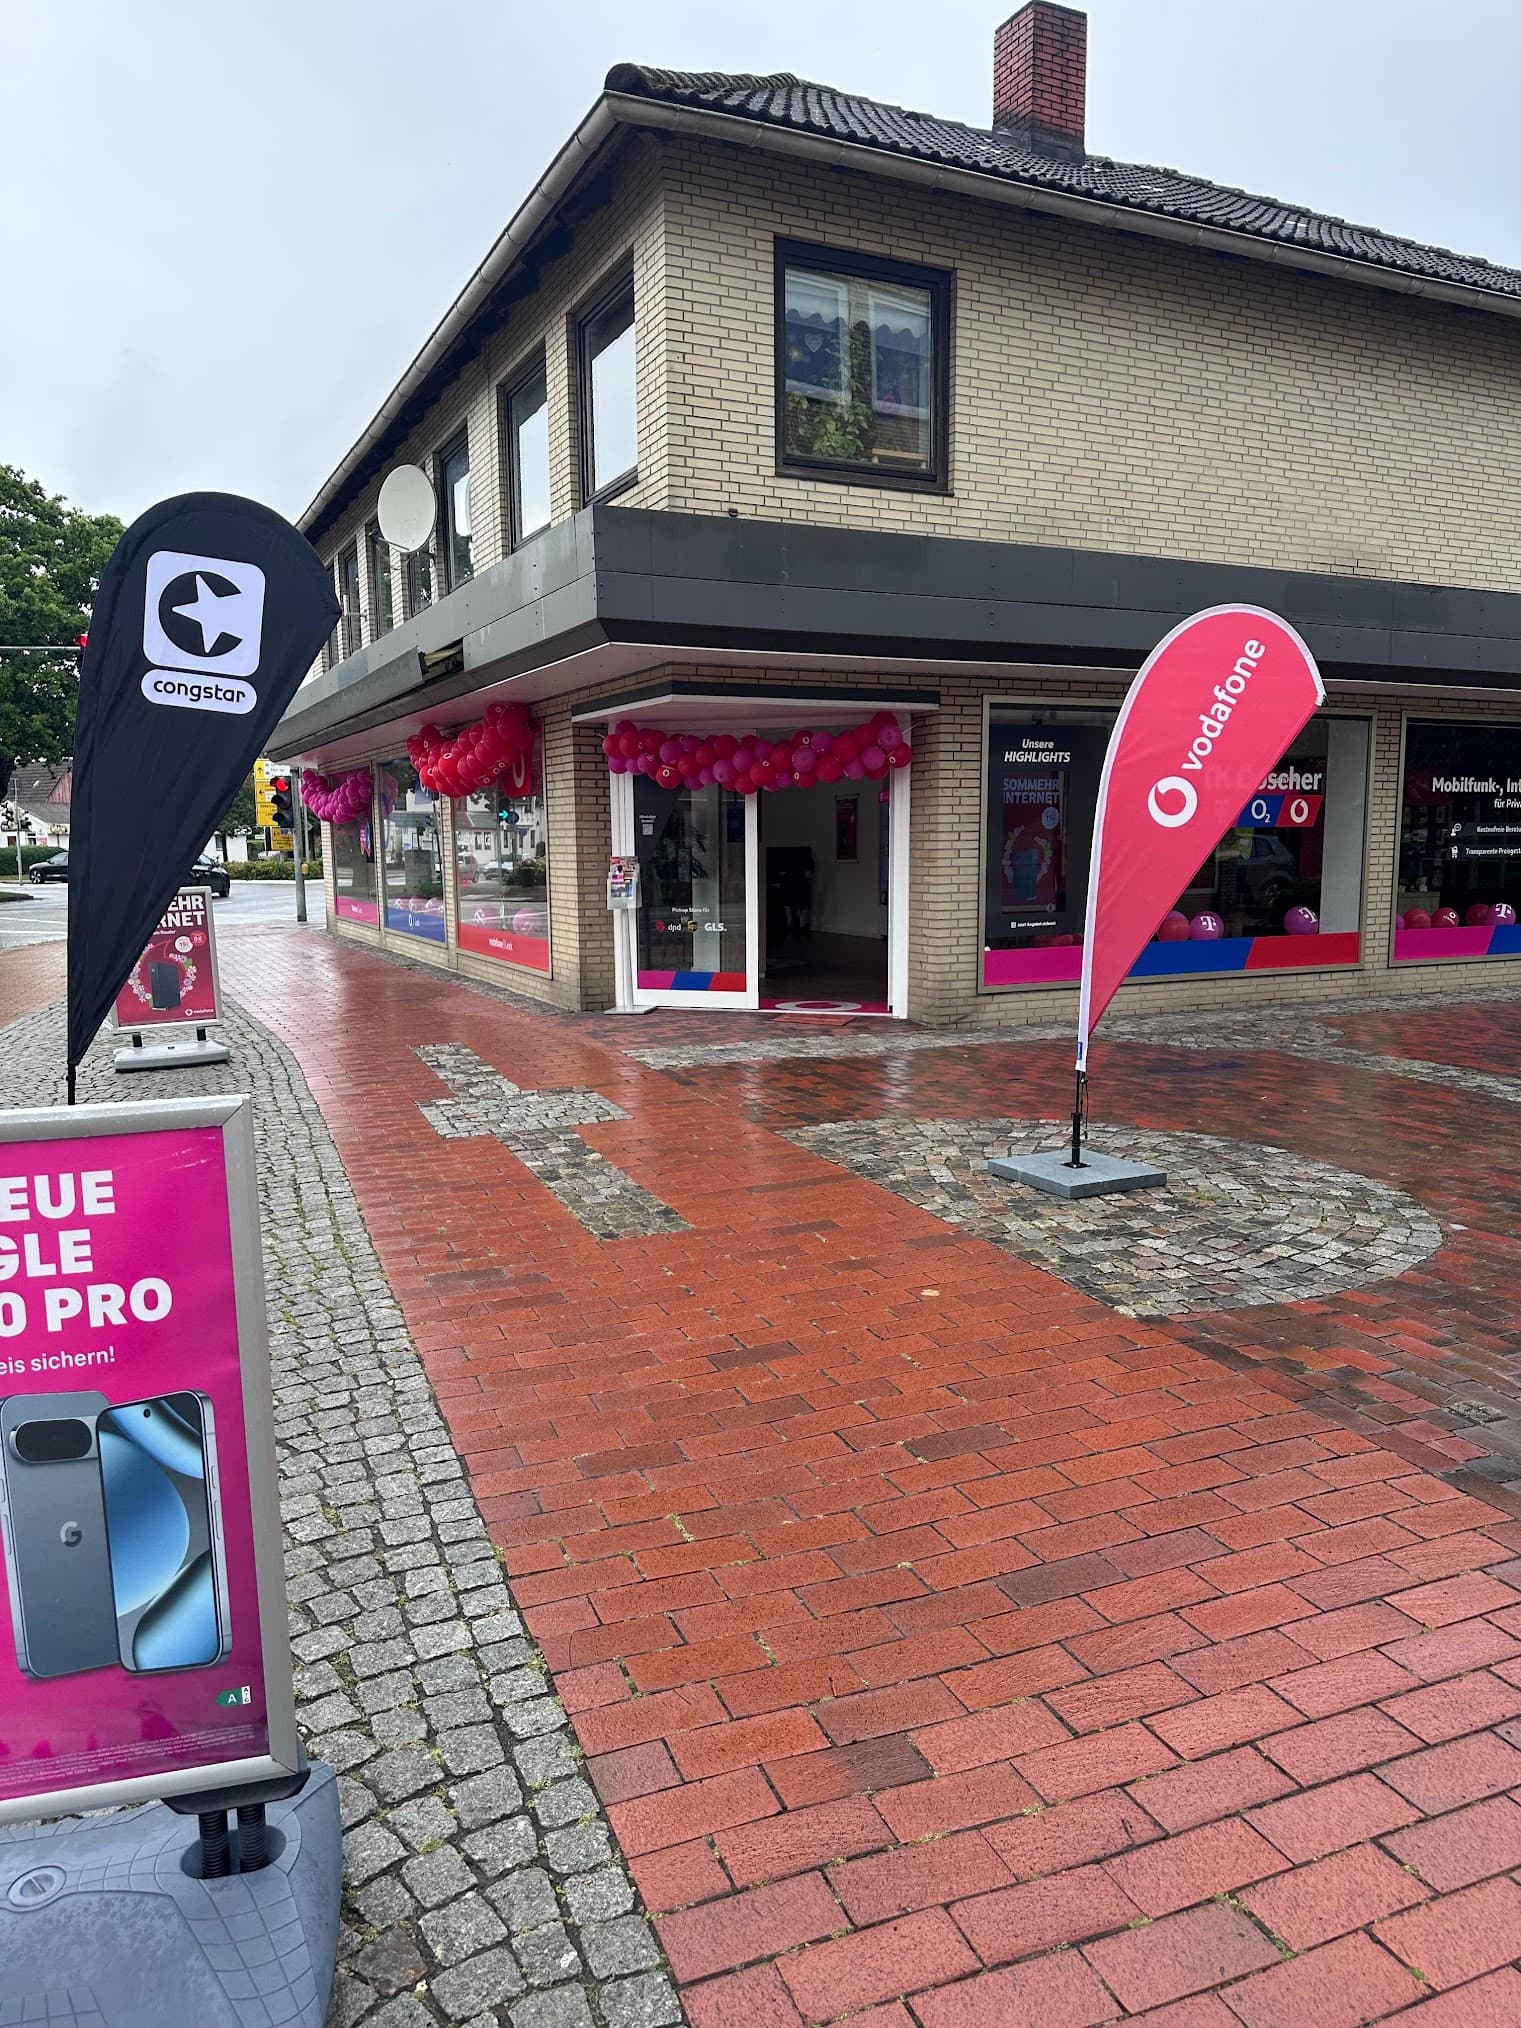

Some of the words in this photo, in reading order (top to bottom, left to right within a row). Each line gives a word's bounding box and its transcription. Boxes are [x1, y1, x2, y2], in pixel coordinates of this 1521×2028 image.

[153, 680, 246, 703] congstar
[1181, 639, 1266, 770] vodafone
[1022, 738, 1054, 749] Unsere
[1004, 751, 1071, 762] HIGHLIGHTS
[1003, 778, 1060, 790] SOMMEHR
[1432, 777, 1504, 796] Mobilfunk-,
[1003, 792, 1059, 804] INTERNET
[1494, 799, 1505, 808] für
[668, 923, 681, 932] dpd
[44, 1278, 172, 1332] PRO
[31, 1346, 115, 1370] sichern!
